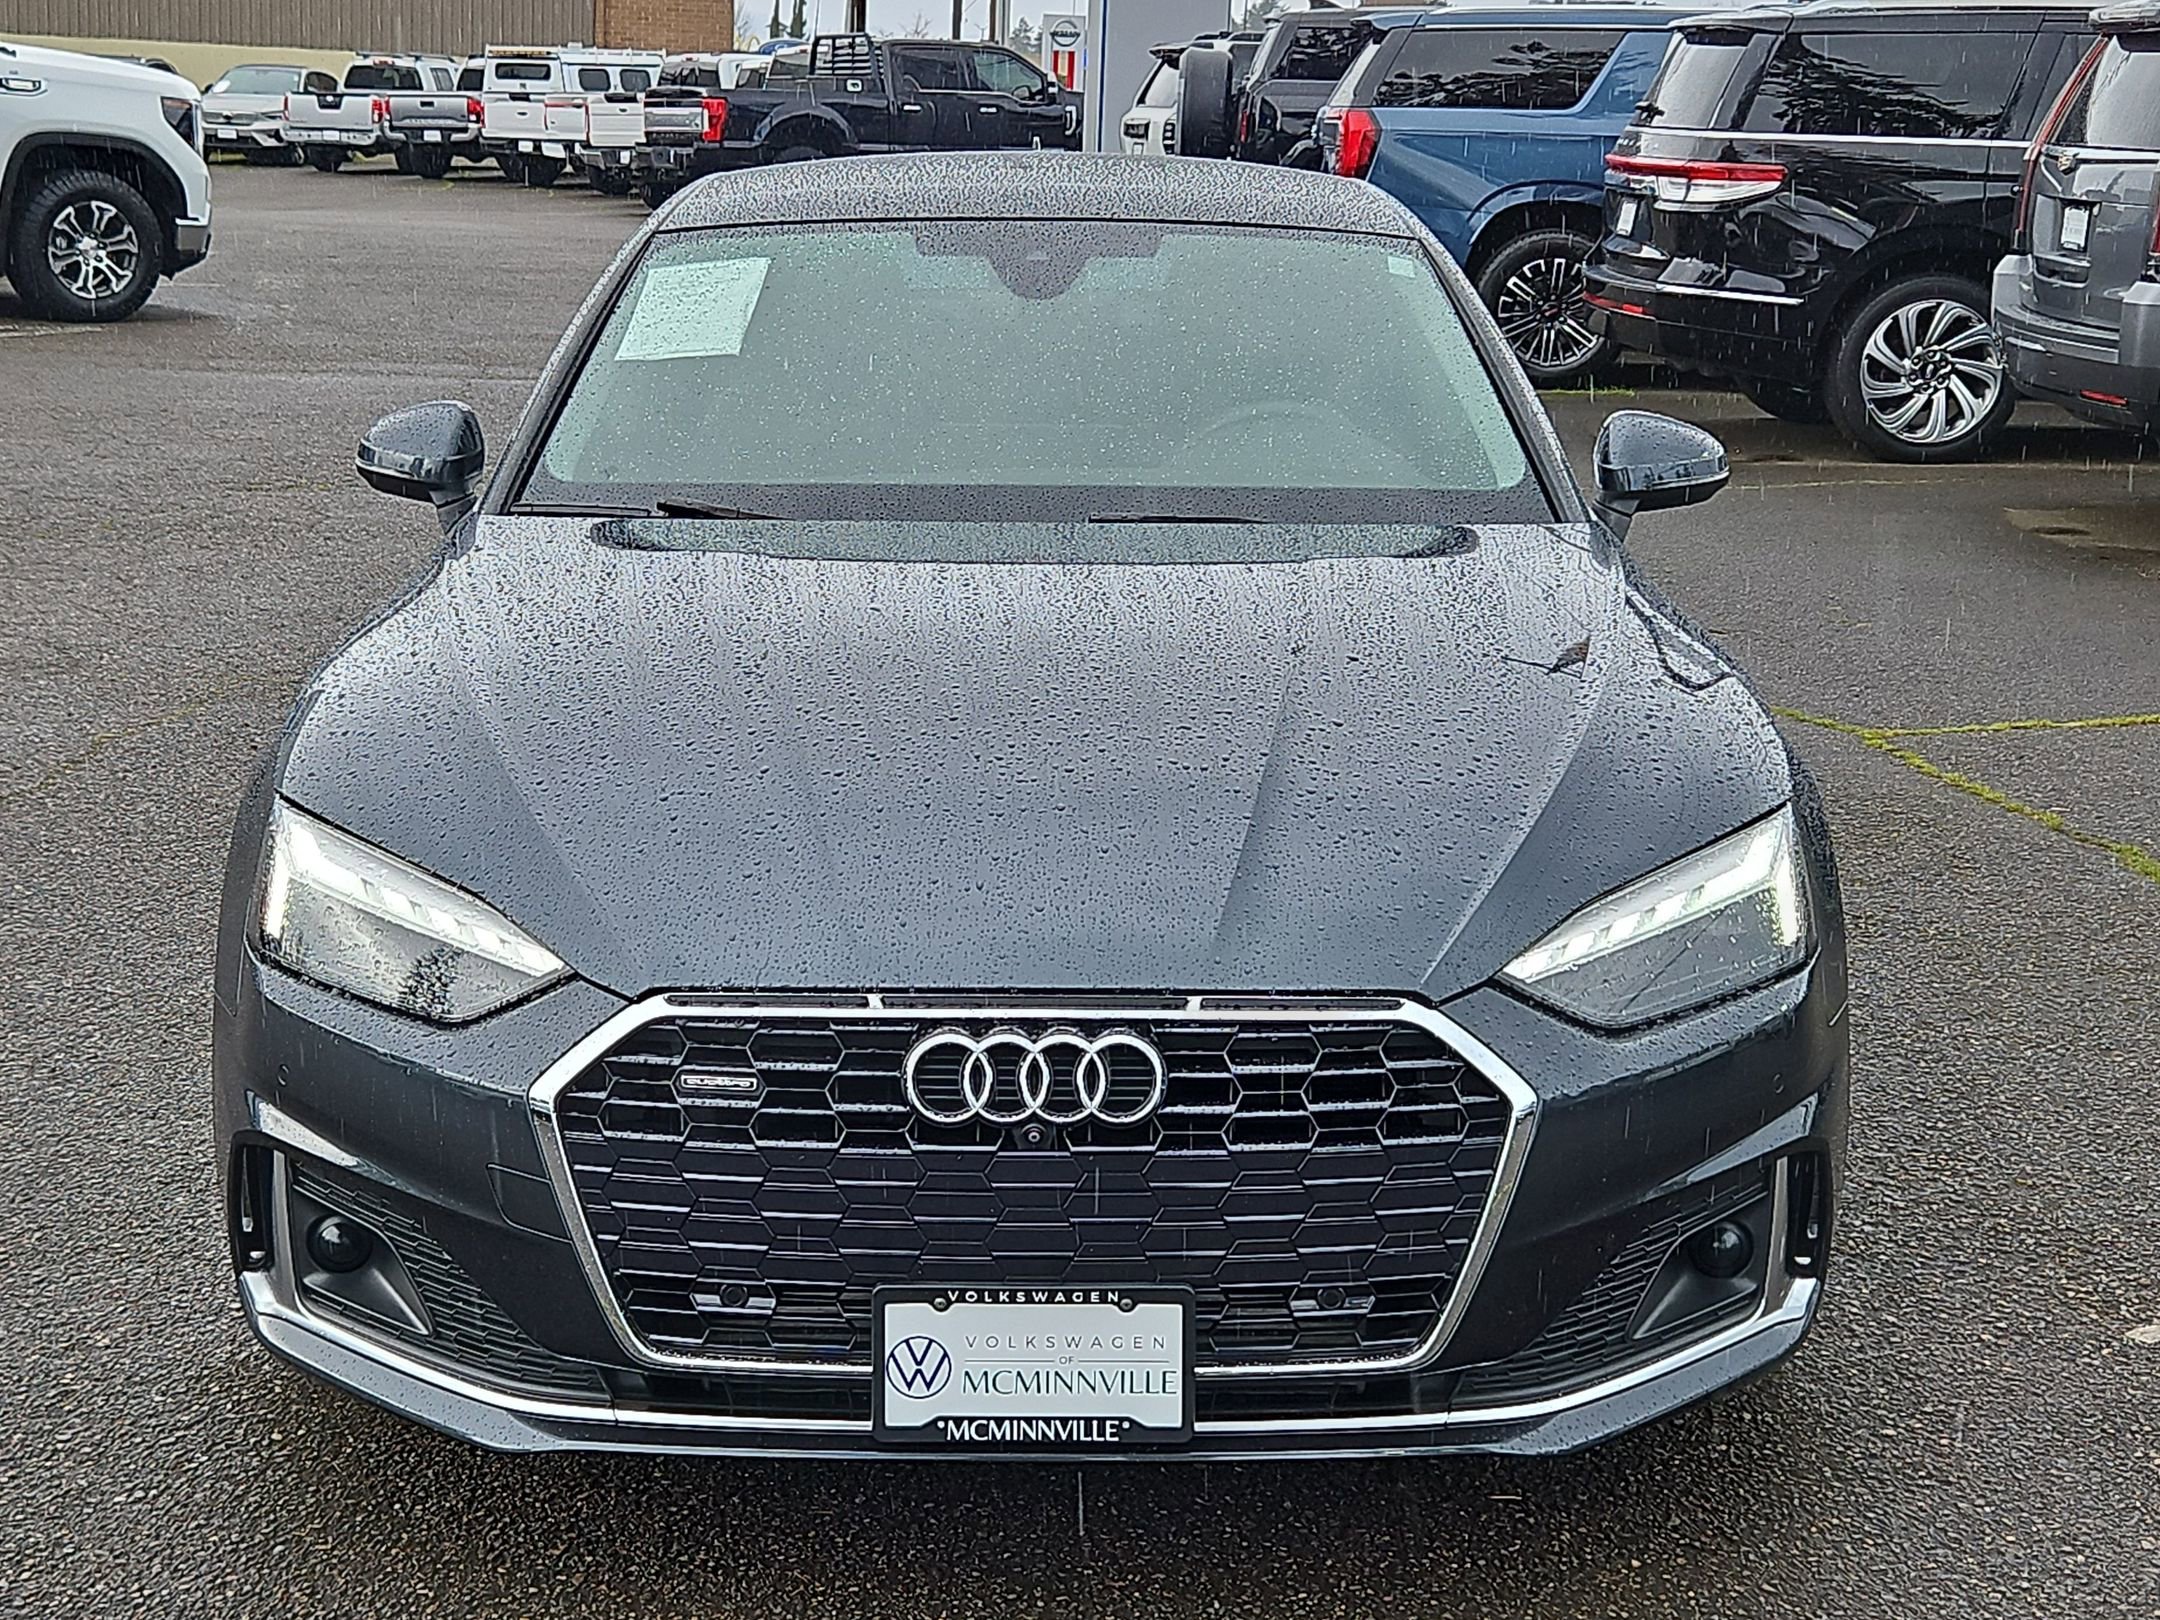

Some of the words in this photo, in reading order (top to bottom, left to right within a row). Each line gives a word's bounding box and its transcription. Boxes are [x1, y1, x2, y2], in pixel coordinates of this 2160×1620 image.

[947, 1290, 1120, 1303] VOLKSWAGEN
[965, 1335, 1166, 1349] VOLKSWAGEN
[1058, 1355, 1075, 1365] OF
[962, 1369, 1178, 1395] MCMINNVILLE
[945, 1419, 1120, 1442] MCMINNVILLE
